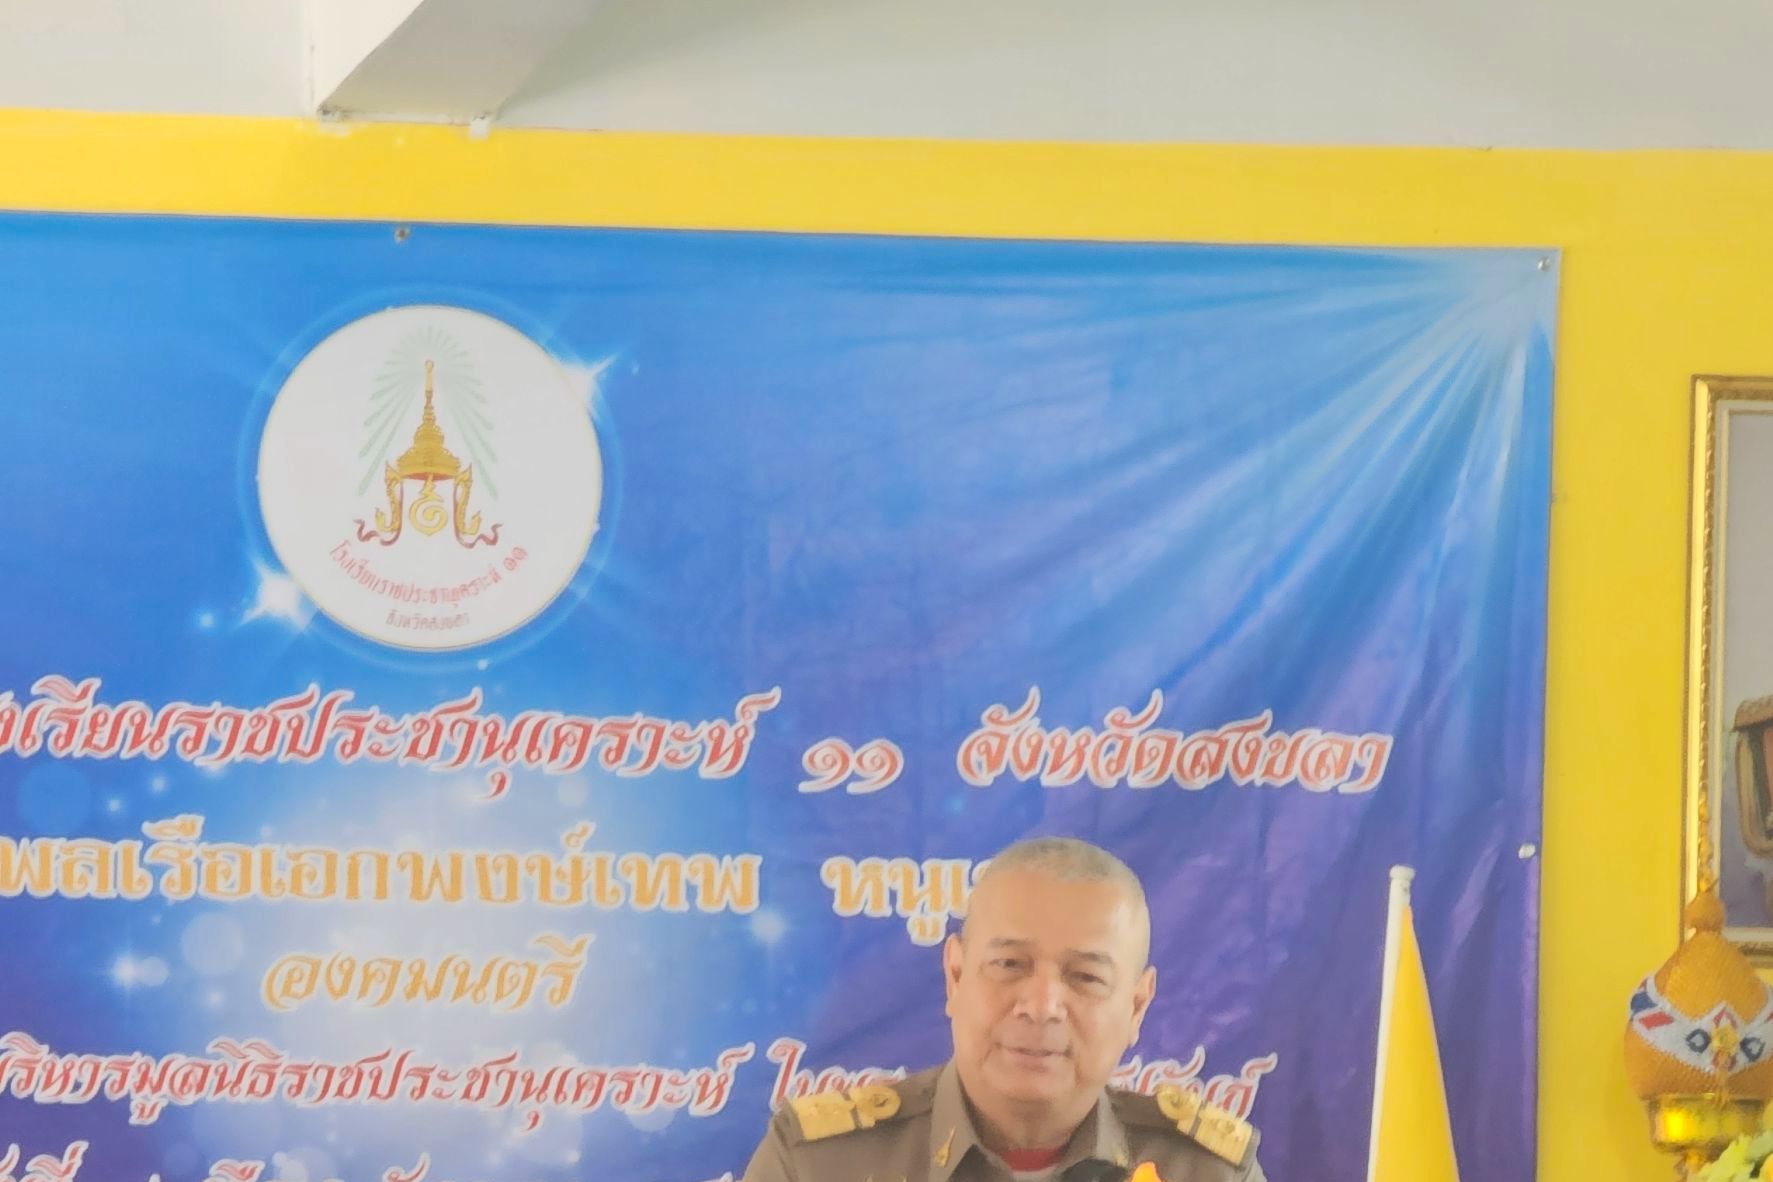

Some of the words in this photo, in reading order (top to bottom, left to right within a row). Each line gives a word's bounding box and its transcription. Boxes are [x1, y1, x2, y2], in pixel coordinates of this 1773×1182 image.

[0, 674, 781, 798] งเรียนราชประชานุเคราะห์
[799, 738, 903, 794] ๑๑
[957, 685, 1393, 793] จังหวัดสงขลา
[0, 815, 762, 914] พลเรือเอกพงษ์เทพ
[820, 855, 993, 947] หนูเ
[262, 933, 595, 1011] องคมนตรี
